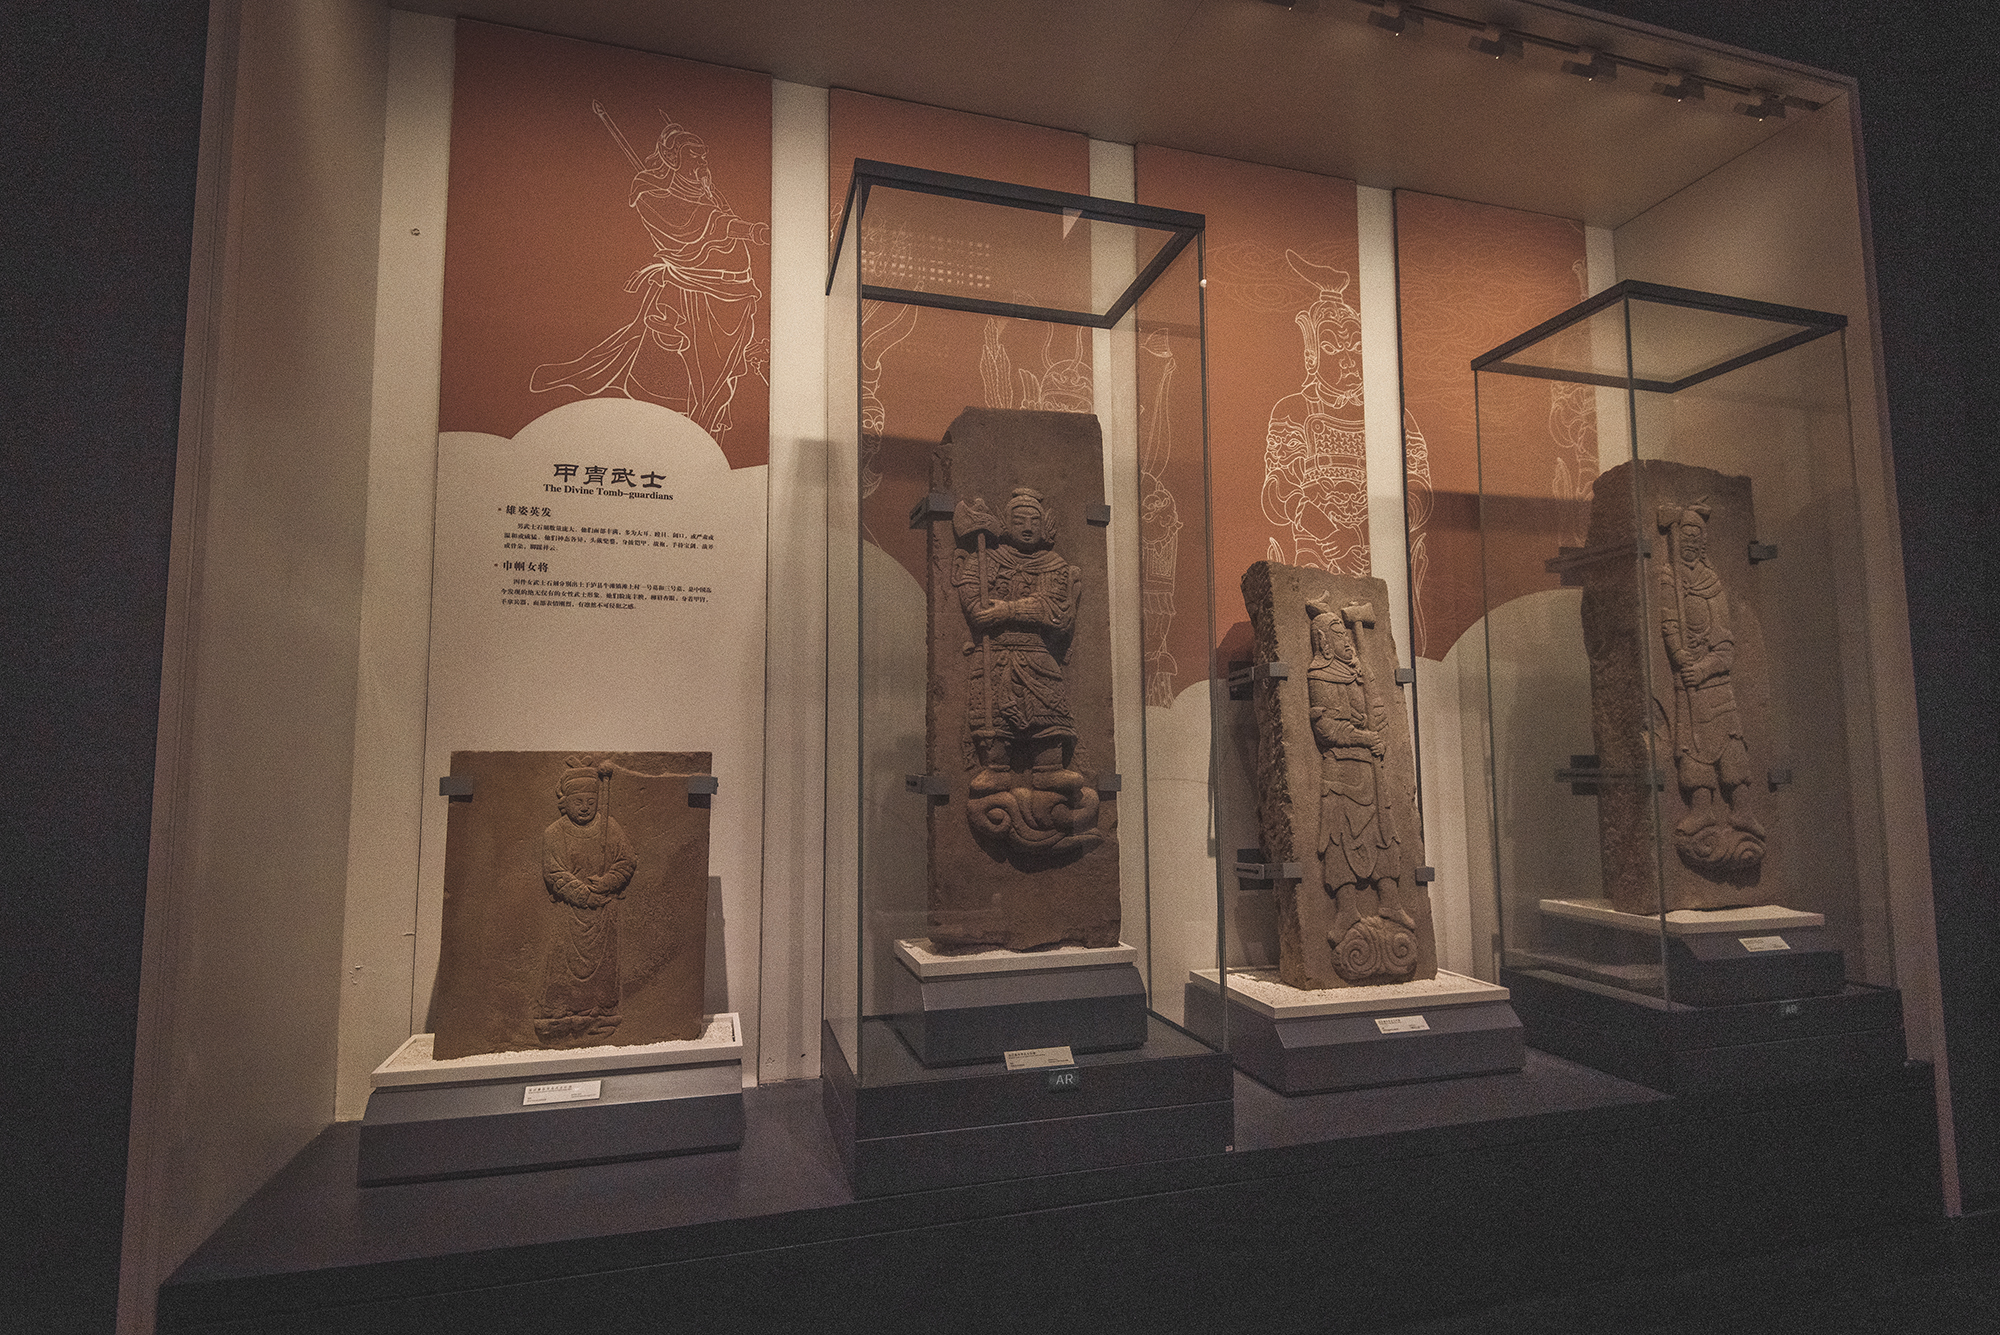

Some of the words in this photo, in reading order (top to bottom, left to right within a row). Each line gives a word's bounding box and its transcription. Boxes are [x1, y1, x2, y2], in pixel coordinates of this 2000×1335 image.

[553, 463, 667, 489] 甲胄武士
[543, 483, 562, 493] The
[564, 484, 594, 495] Divine
[596, 487, 674, 501] Tomb-guardians
[505, 504, 552, 517] 雄姿英发
[502, 560, 549, 573] 巾帼女将
[1055, 1073, 1074, 1085] AR
